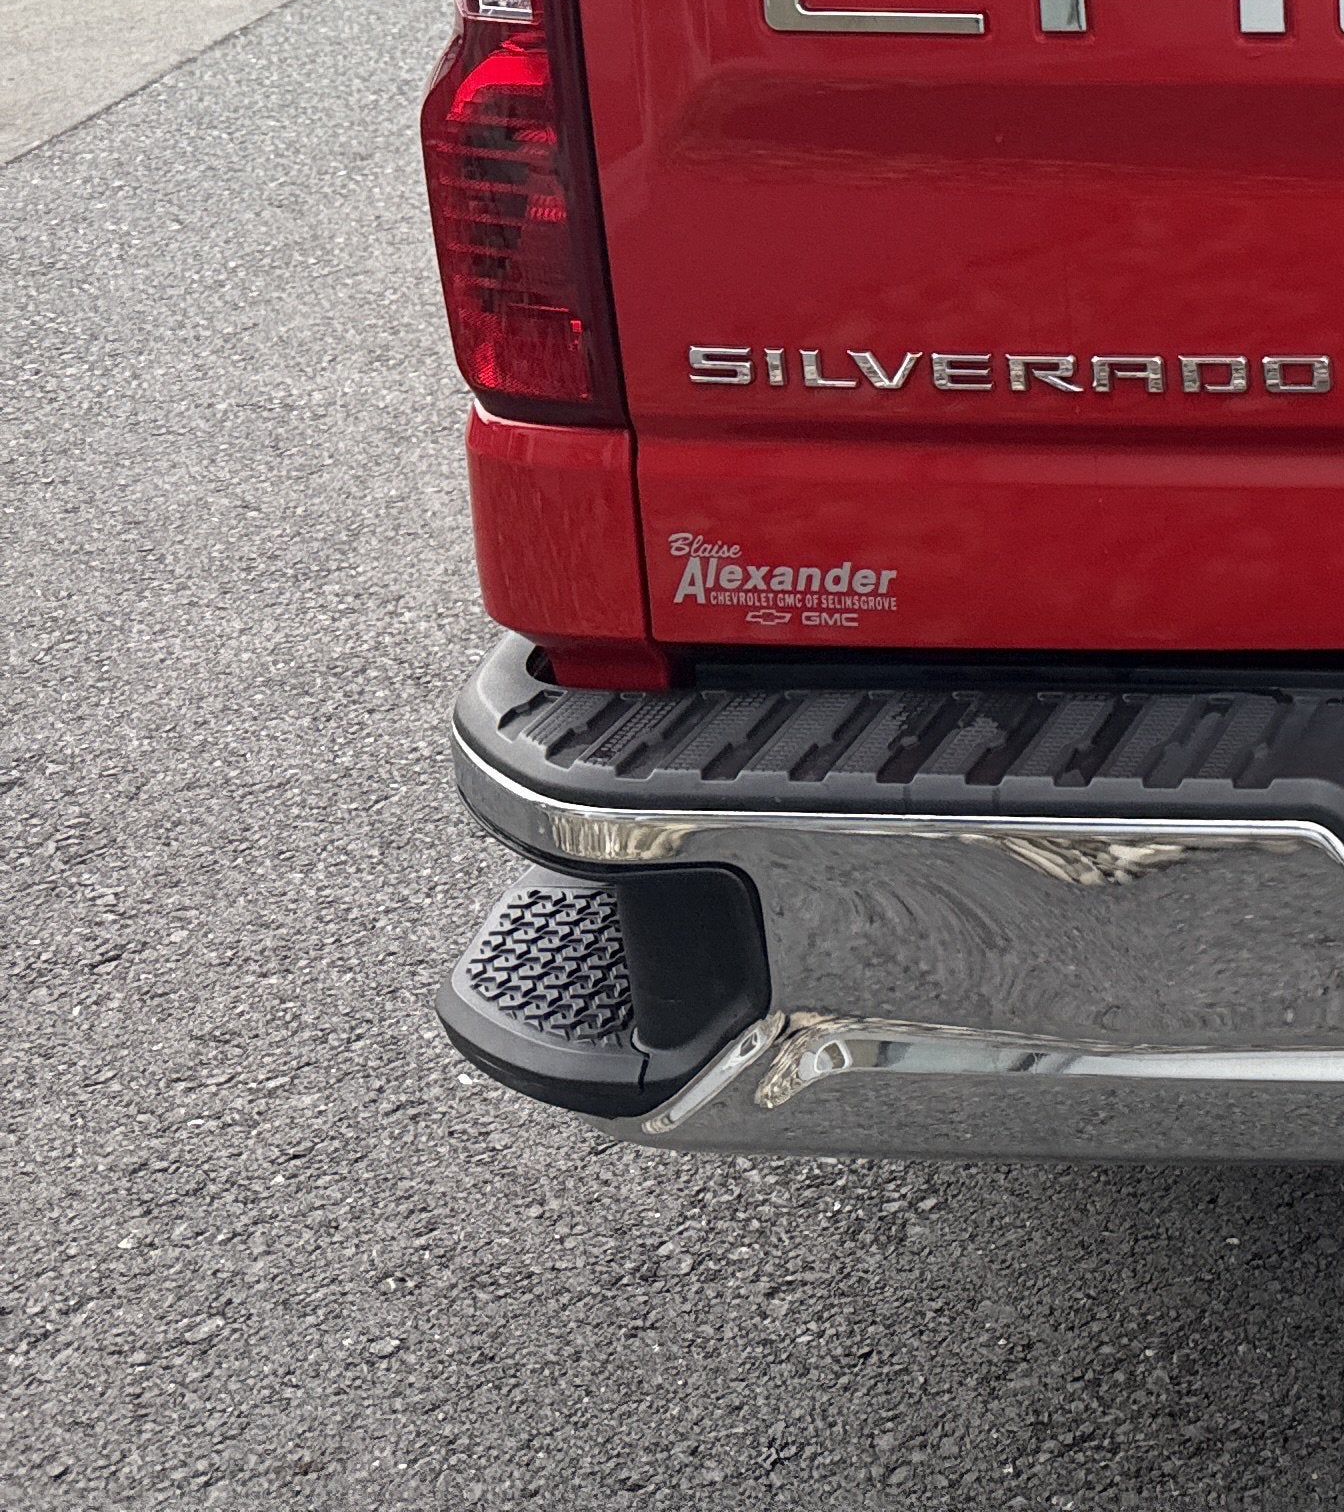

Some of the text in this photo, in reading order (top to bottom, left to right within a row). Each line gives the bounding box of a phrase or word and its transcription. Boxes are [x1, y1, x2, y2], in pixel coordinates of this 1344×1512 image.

[687, 344, 1334, 395] SILVERADO
[668, 532, 743, 559] Blaise
[673, 557, 898, 604] Alexander
[710, 591, 898, 611] CHEVROLET GMC OF SELINSGROVE
[801, 611, 860, 627] GMC
